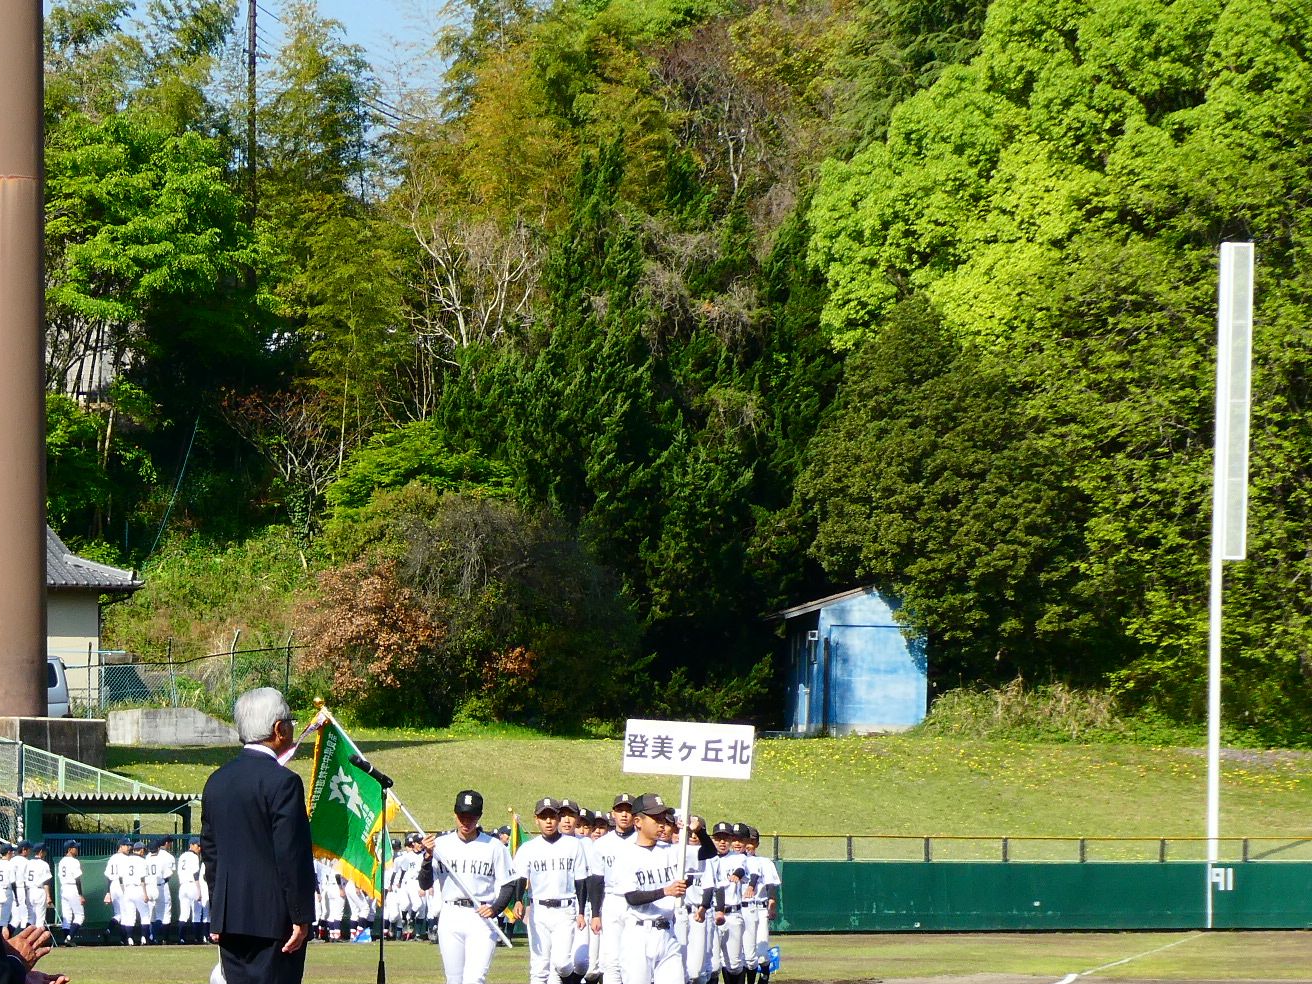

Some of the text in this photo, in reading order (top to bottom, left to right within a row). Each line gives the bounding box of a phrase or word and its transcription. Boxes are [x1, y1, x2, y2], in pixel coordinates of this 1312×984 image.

[27, 870, 35, 882] 5
[128, 864, 134, 876] 3
[1210, 867, 1234, 891] 91
